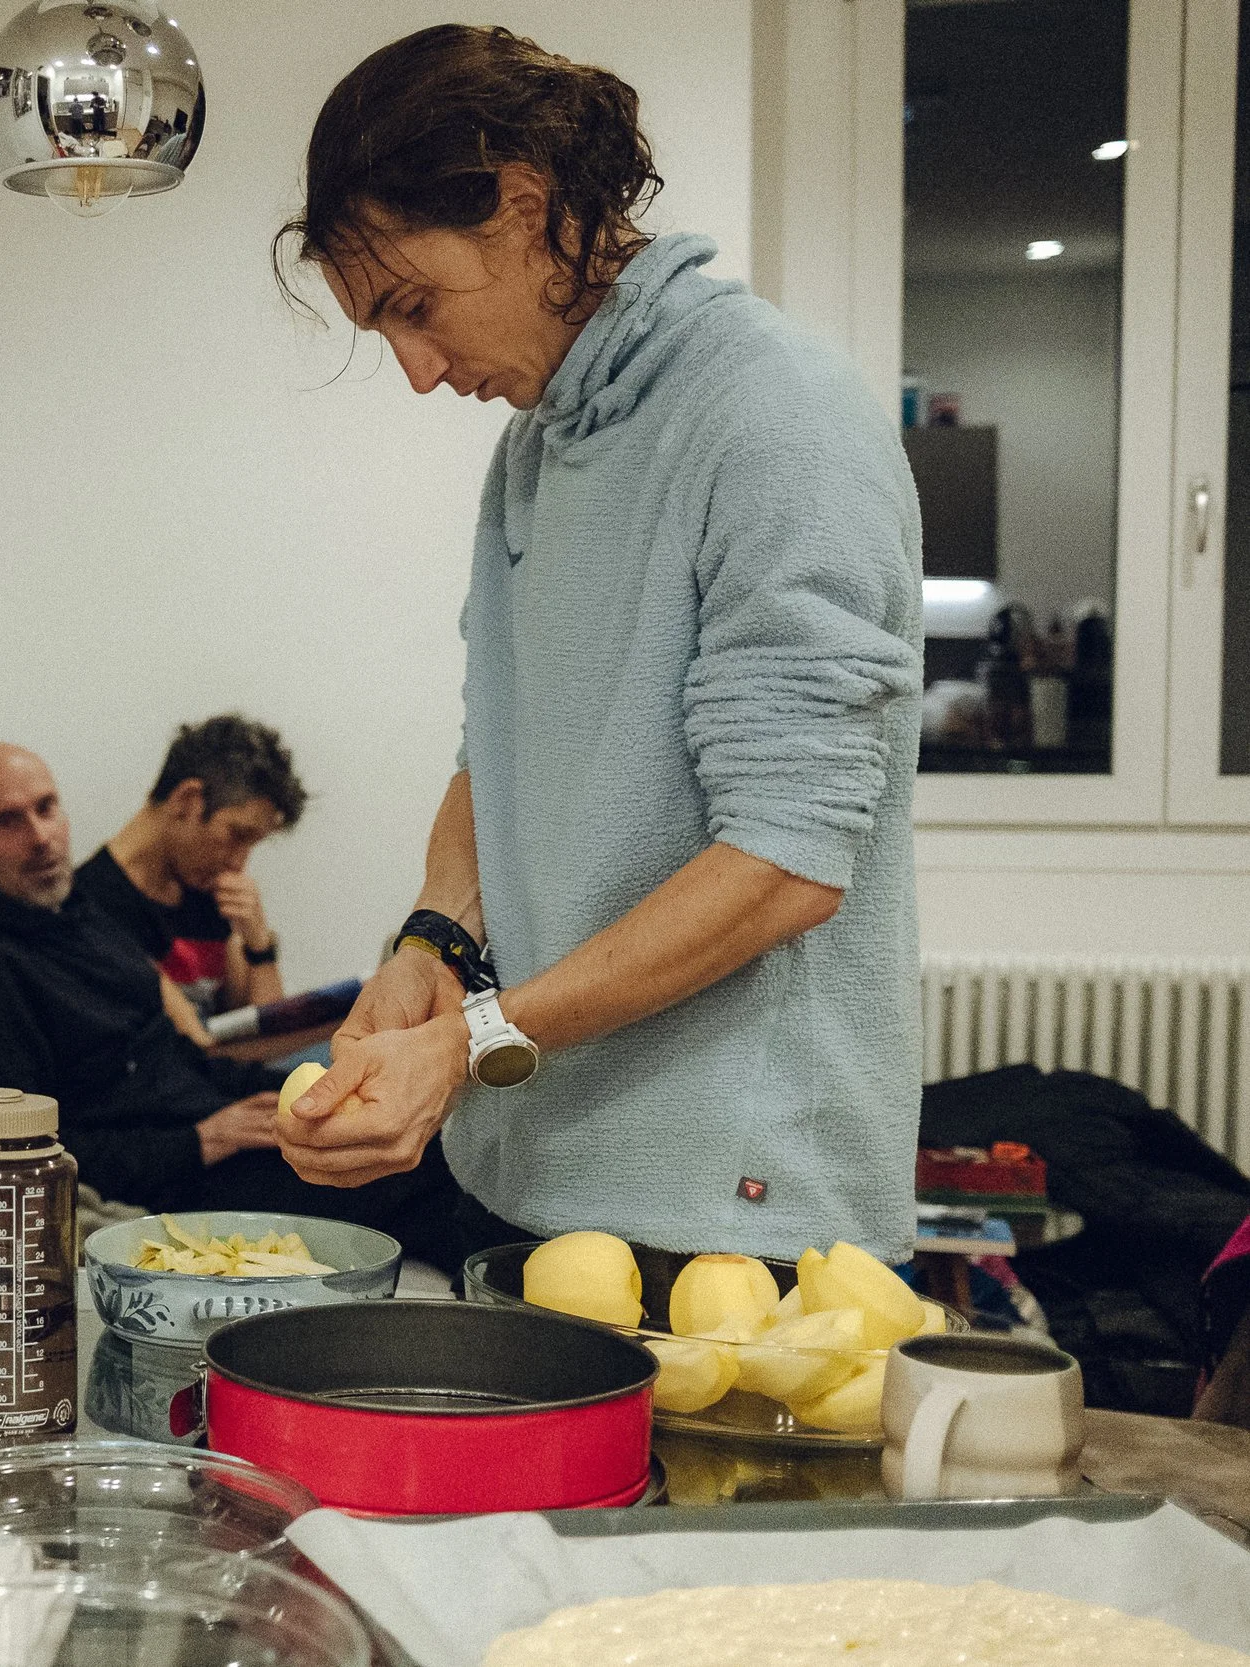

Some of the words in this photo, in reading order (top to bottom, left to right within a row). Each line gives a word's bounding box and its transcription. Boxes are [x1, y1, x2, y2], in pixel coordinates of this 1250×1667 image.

[35, 1218, 45, 1226] 28
[35, 1251, 45, 1259] 24
[35, 1284, 45, 1292] 20
[5, 1413, 46, 1425] nalgene
